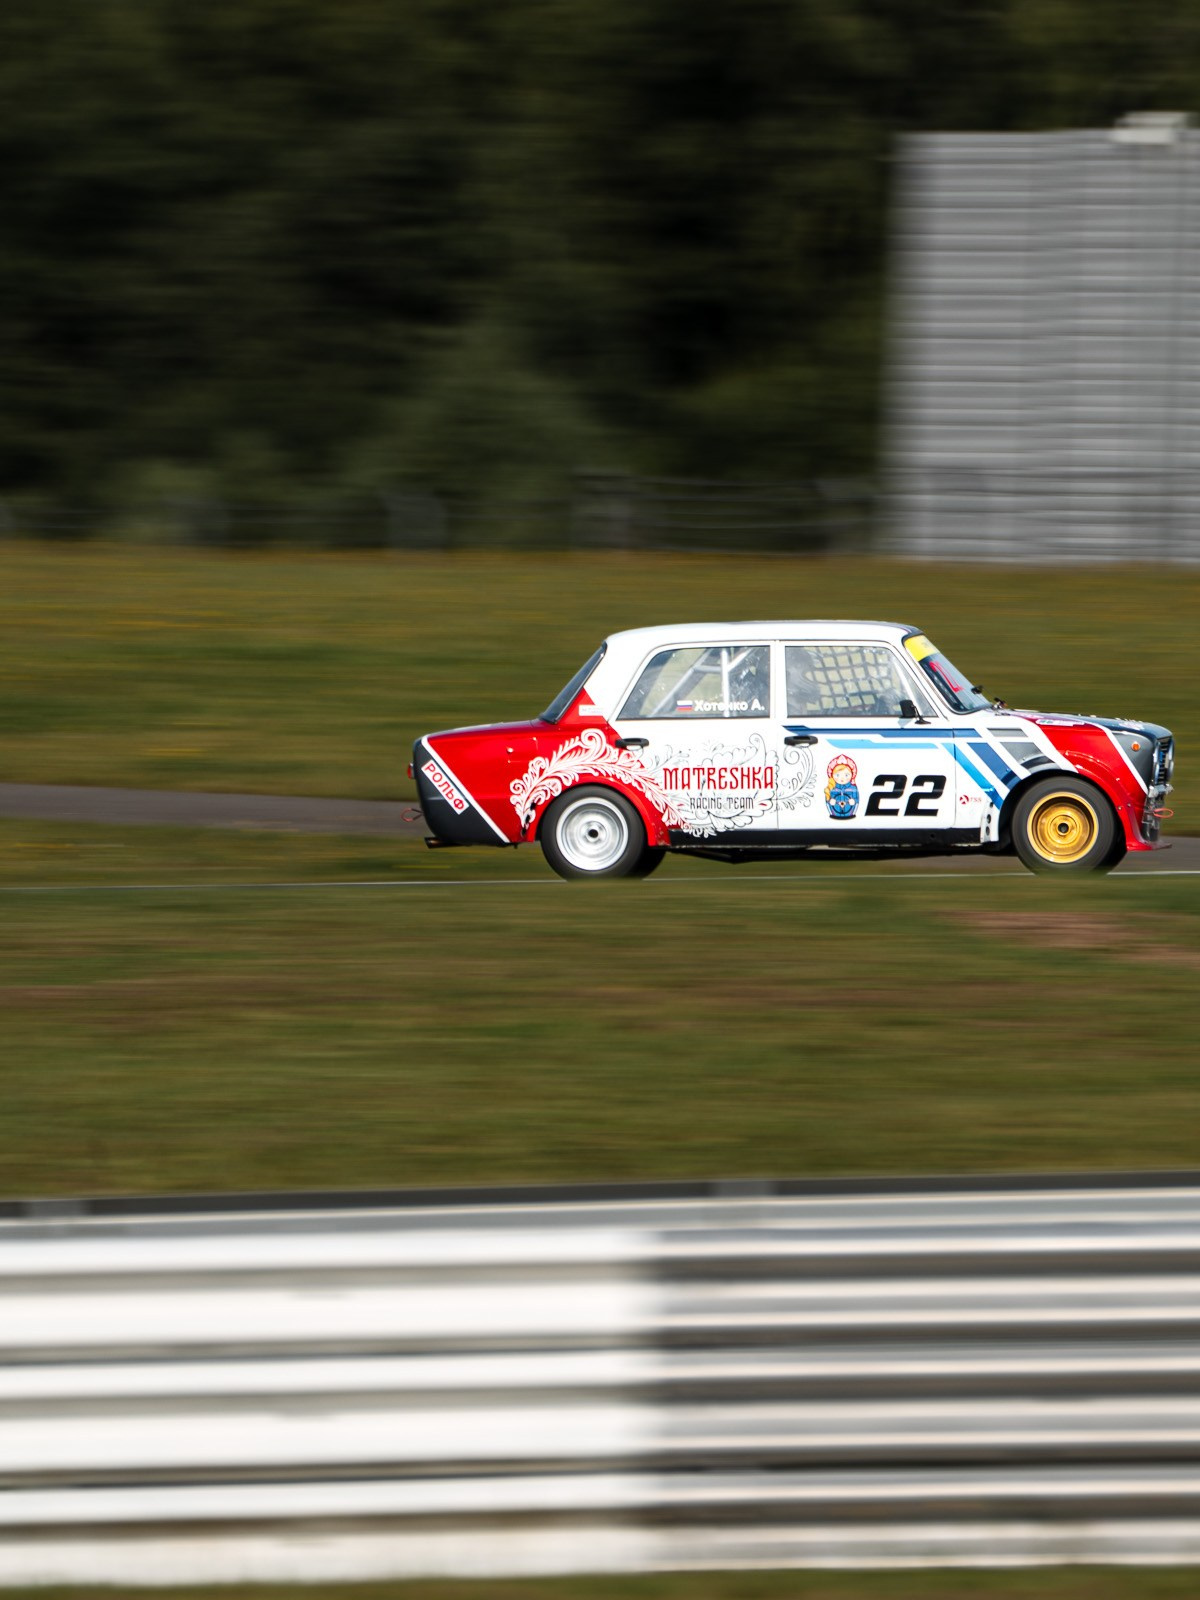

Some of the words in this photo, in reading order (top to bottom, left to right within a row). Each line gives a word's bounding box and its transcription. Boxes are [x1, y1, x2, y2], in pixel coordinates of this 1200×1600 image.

[424, 763, 465, 810] РОЛЬФ
[662, 766, 775, 790] MATRESHKA
[690, 797, 722, 809] RACING
[726, 797, 754, 809] TEAM
[864, 774, 947, 817] 22
